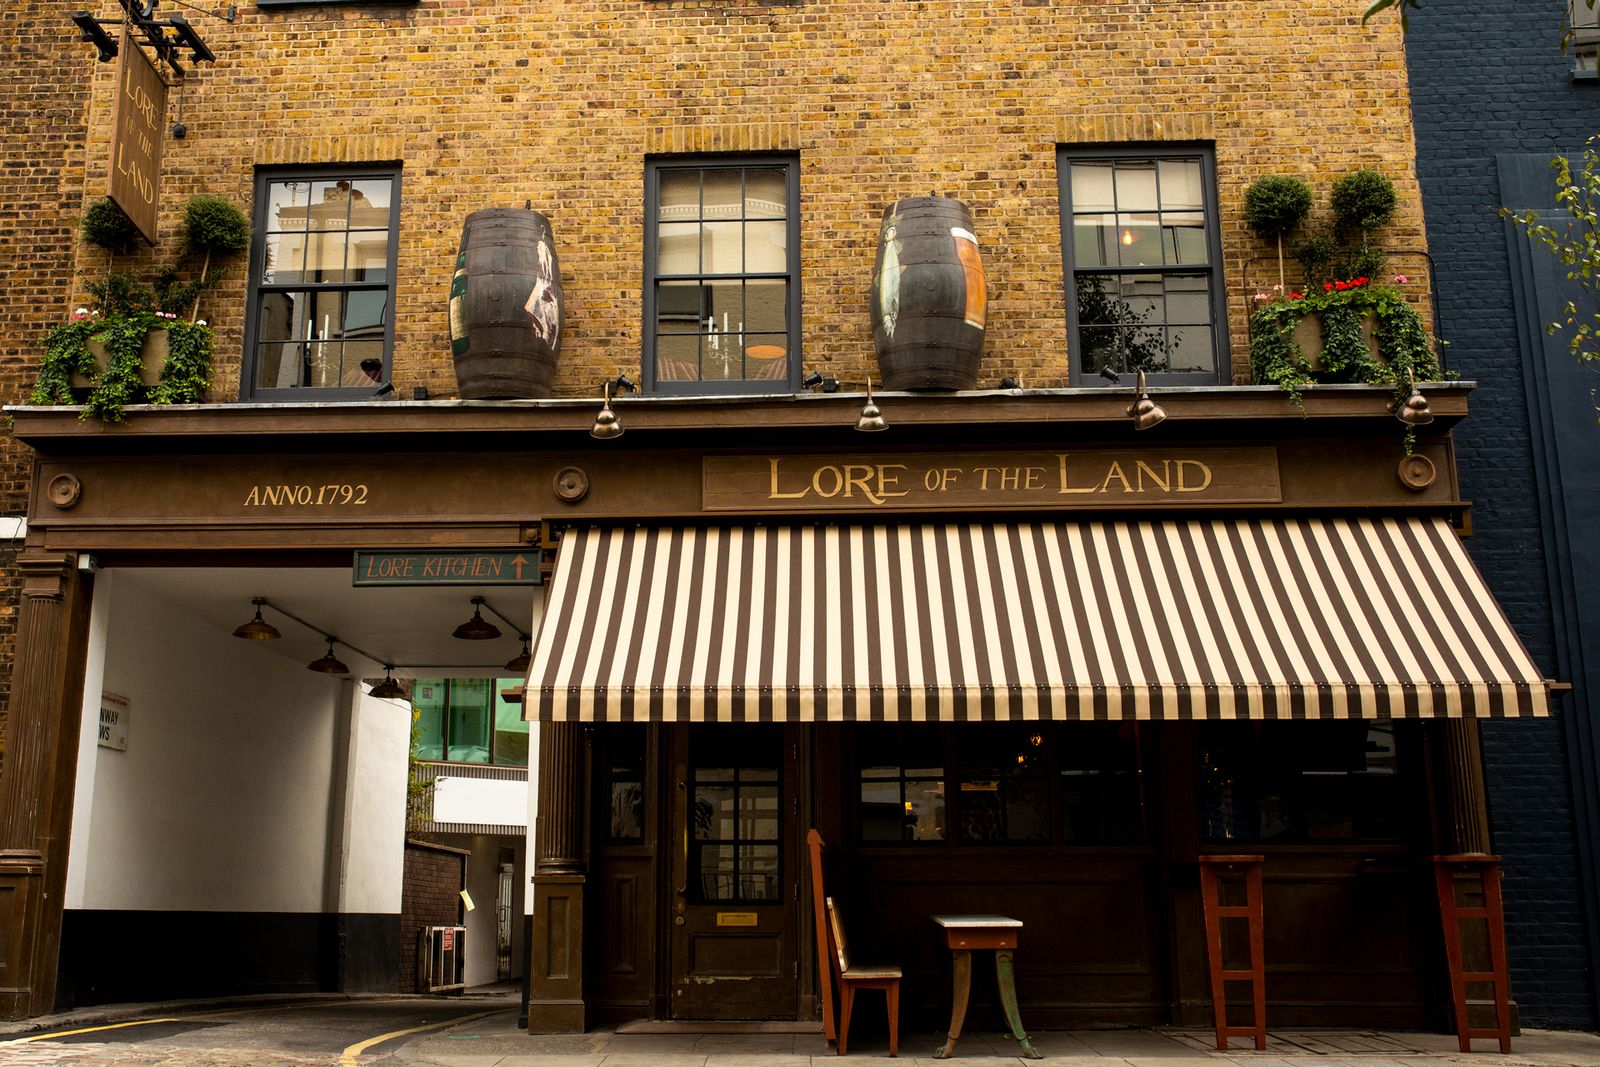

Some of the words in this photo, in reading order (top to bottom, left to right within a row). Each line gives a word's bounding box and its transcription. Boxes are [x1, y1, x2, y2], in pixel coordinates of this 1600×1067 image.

[125, 68, 158, 131] LORE
[125, 116, 136, 135] OF
[137, 129, 153, 160] THE
[117, 142, 154, 205] LAND
[243, 484, 368, 506] ANNO.1792
[767, 458, 911, 505] LORE
[924, 468, 964, 491] OF
[972, 466, 1048, 490] THE
[1056, 454, 1213, 494] LAND
[367, 555, 417, 577] LORE
[423, 556, 504, 577] KITCHEN
[100, 707, 119, 725] NWAY
